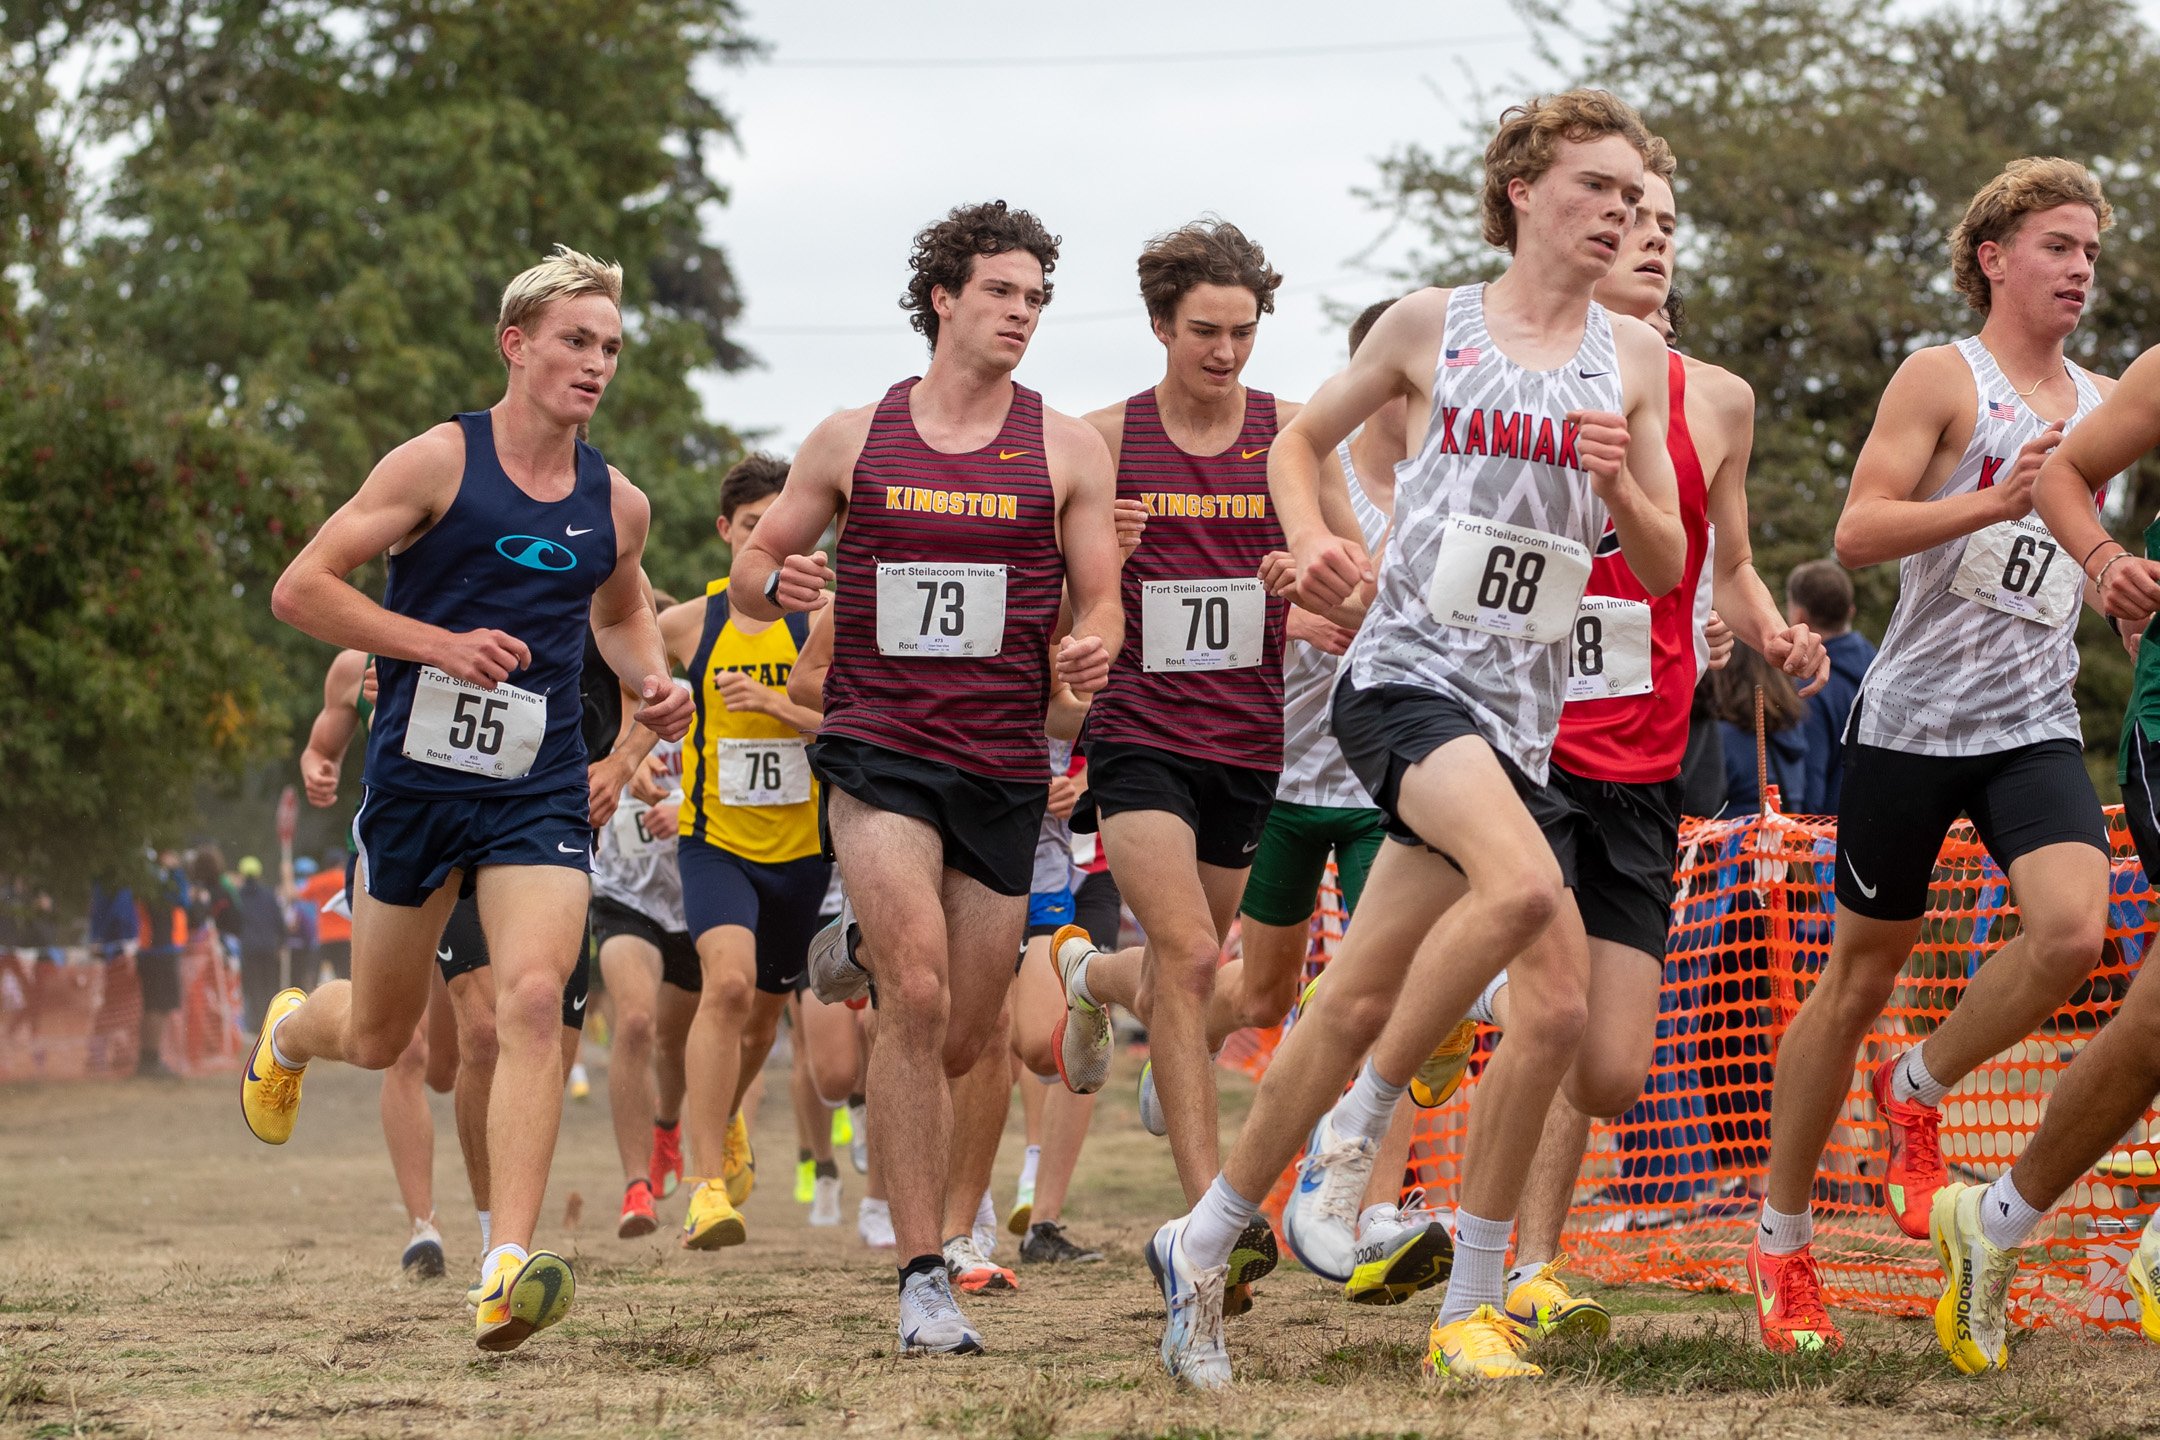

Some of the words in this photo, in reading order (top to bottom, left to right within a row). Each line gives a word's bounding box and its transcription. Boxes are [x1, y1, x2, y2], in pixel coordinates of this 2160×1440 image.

[1439, 406, 1589, 473] KAMIAK
[886, 486, 1017, 520] KINGSTON
[1140, 493, 1265, 519] KINGSTON
[1457, 520, 1481, 534] Fort
[1484, 526, 1549, 549] Steilacoom
[1551, 541, 1580, 556] Invite
[2010, 520, 2054, 537] Steilacoo
[885, 567, 905, 576] Fort
[908, 567, 965, 577] Steilacoom
[967, 568, 995, 577] Invite
[1477, 545, 1546, 615] 68
[2001, 534, 2057, 598] 67
[1151, 585, 1170, 594] Fort
[1173, 584, 1228, 594] Steilacoom
[1231, 583, 1256, 592] Invite
[1607, 600, 1636, 609] Invite
[1974, 587, 1997, 602] Rout
[917, 581, 965, 636] 73
[1182, 597, 1229, 651] 70
[429, 672, 450, 684] Fort
[511, 690, 536, 704] Invite
[449, 692, 508, 755] 55
[427, 749, 452, 761] Route
[745, 752, 781, 790] 76
[1354, 1242, 1384, 1264] OOKS
[1956, 1258, 1973, 1342] BROOKS
